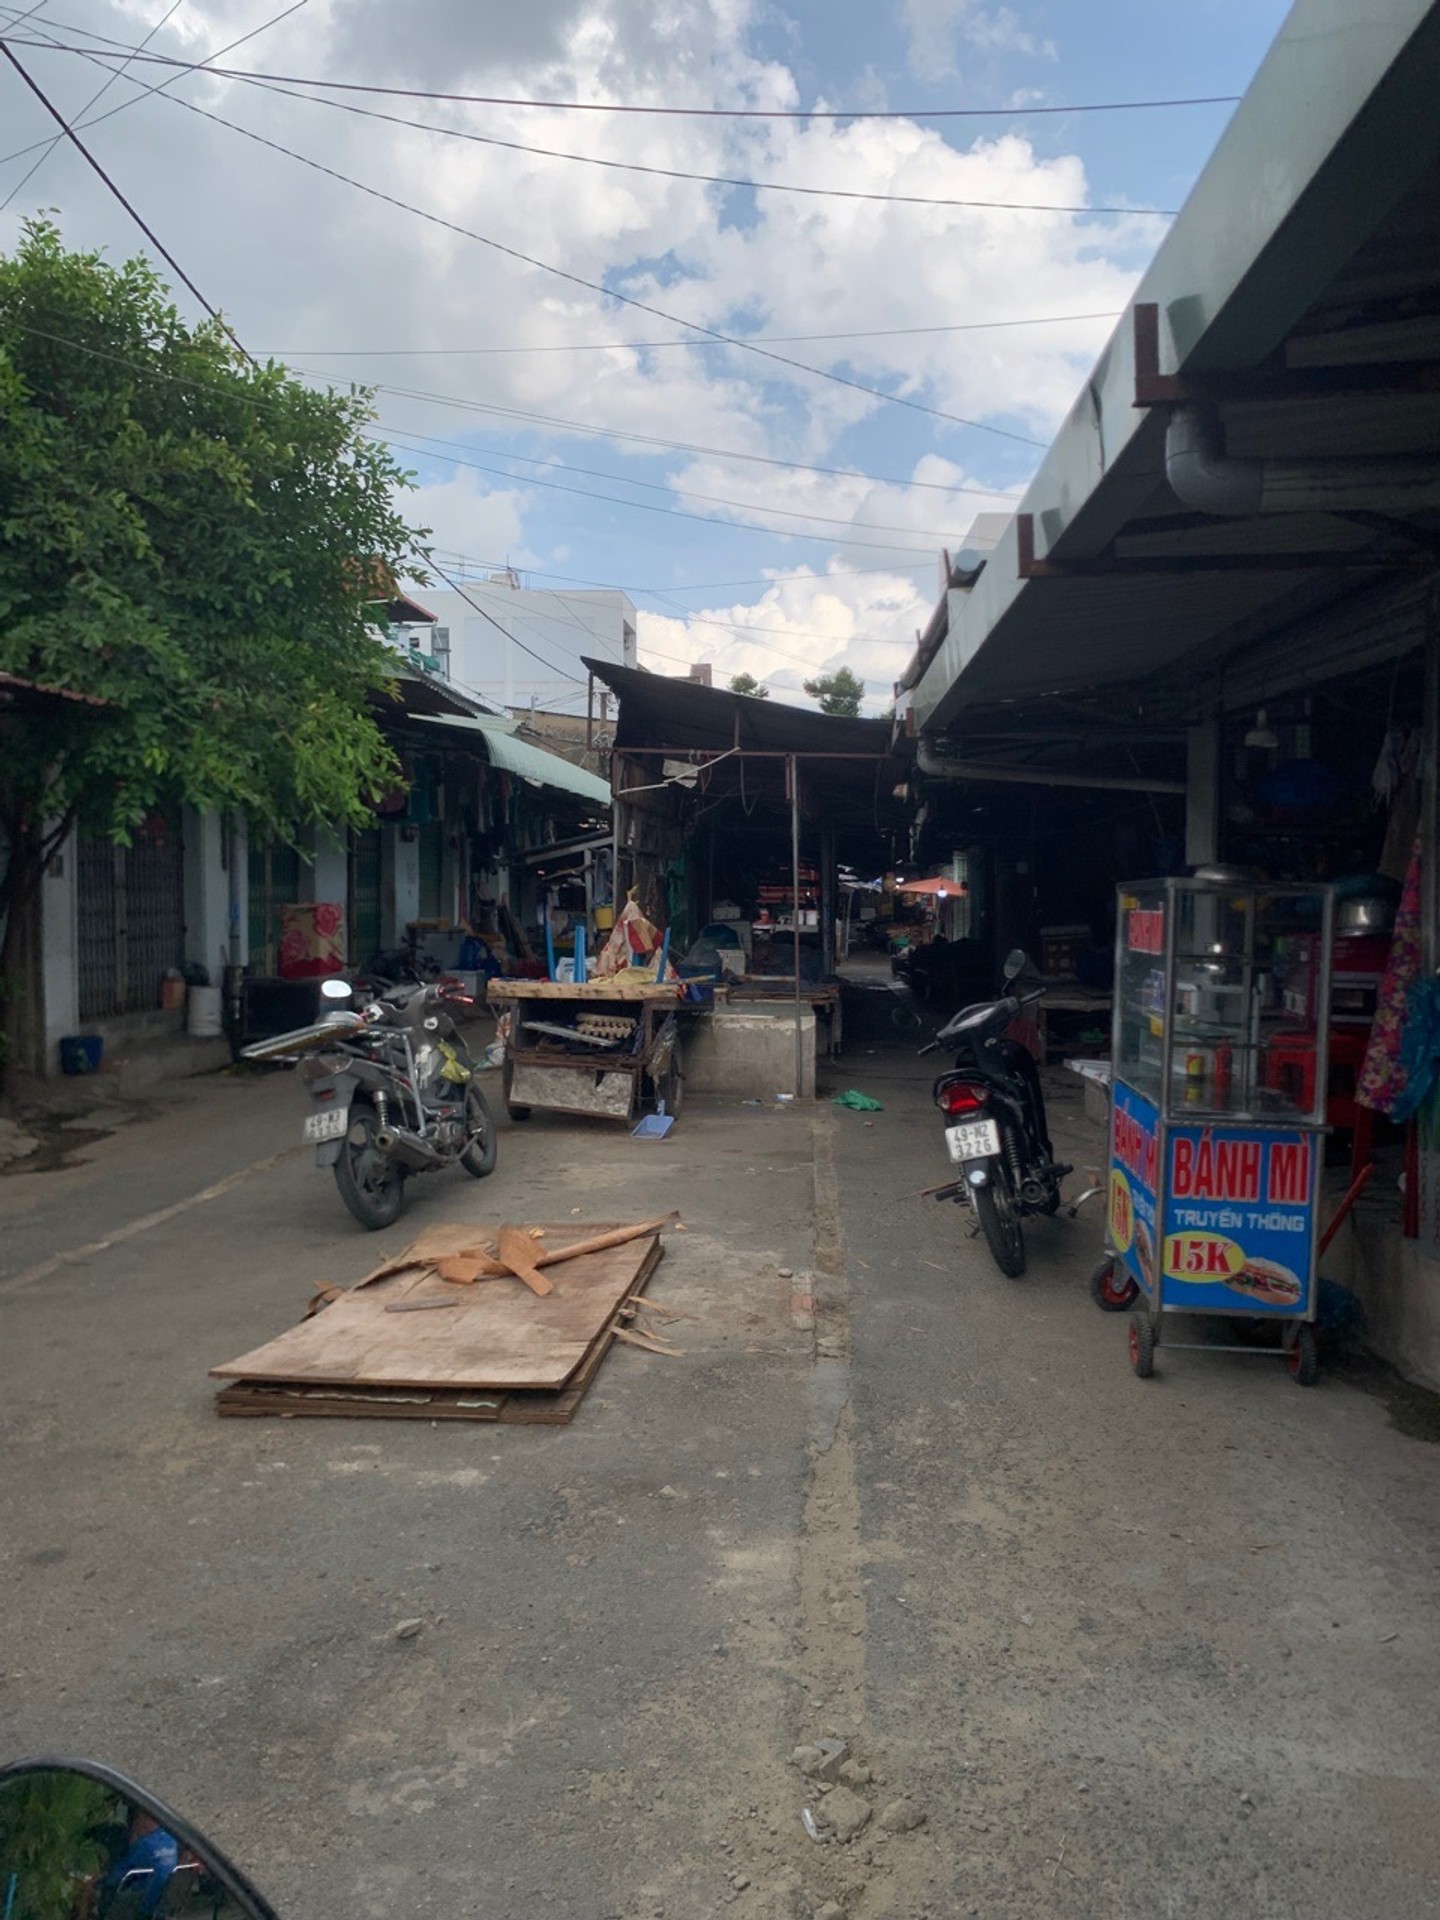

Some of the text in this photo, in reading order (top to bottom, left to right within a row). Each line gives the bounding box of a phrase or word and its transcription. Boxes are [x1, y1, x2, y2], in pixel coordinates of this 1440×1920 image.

[1172, 1126, 1311, 1205] BÁNH MÌ
[1169, 1238, 1234, 1275] 15K
